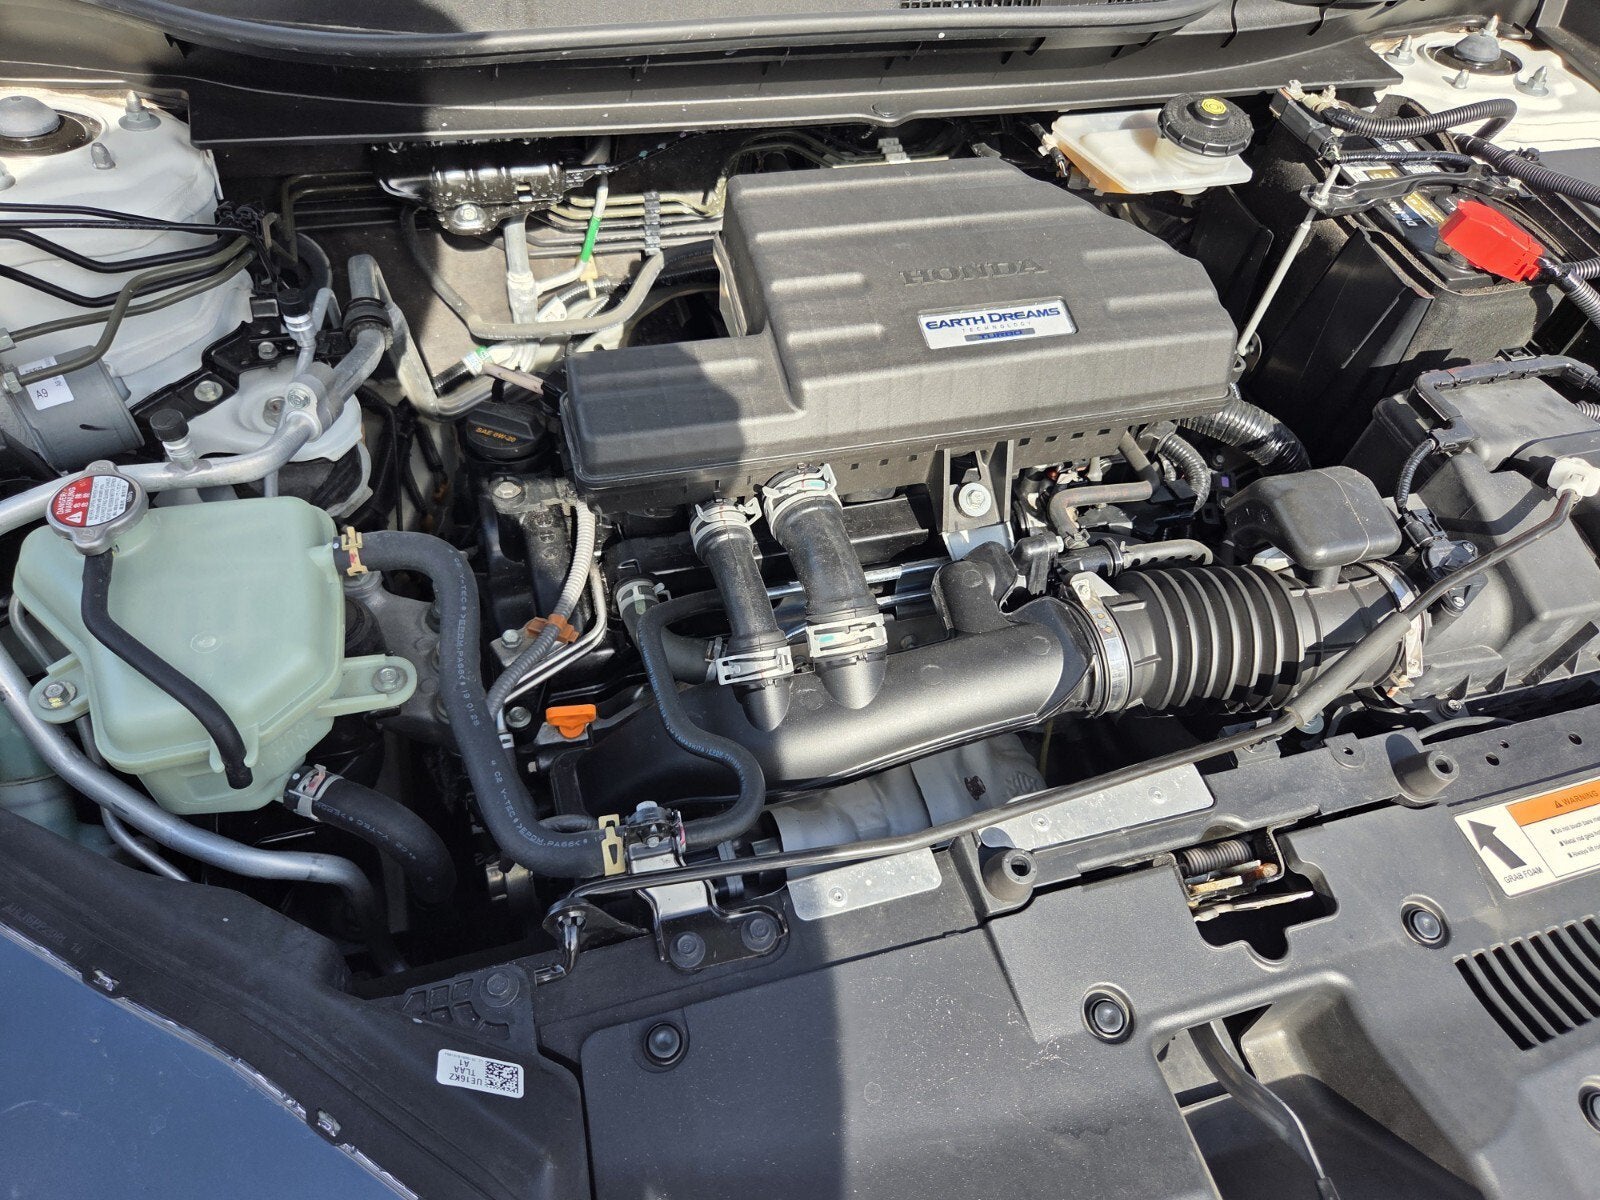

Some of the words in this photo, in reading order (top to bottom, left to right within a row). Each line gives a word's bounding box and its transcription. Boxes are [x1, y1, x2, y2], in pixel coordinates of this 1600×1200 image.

[899, 258, 1048, 286] HONDA
[925, 314, 985, 330] EARTH
[987, 307, 1061, 323] DREAMS
[962, 321, 1032, 333] TECHNOLOGY
[36, 388, 49, 399] A9
[476, 427, 492, 436] SAE
[1562, 790, 1599, 805] WARNING
[1503, 871, 1524, 884] GRAB
[1523, 866, 1543, 878] FOAM
[459, 1059, 470, 1067] A1
[454, 1065, 476, 1077] TLAA
